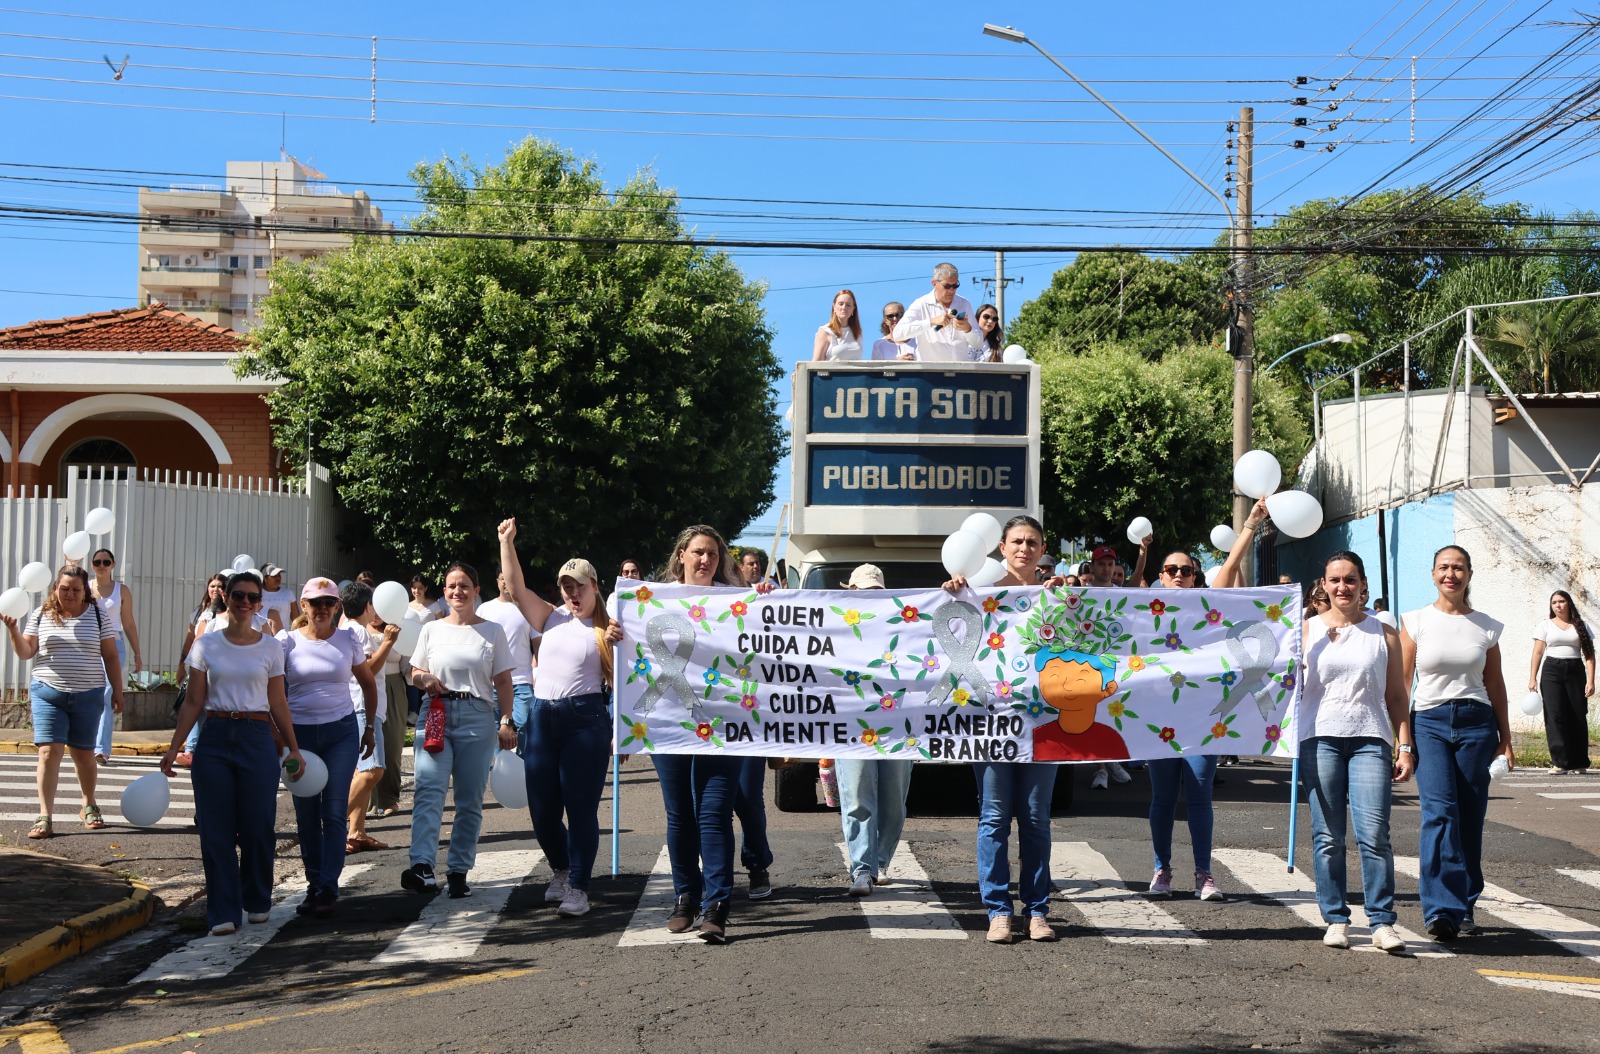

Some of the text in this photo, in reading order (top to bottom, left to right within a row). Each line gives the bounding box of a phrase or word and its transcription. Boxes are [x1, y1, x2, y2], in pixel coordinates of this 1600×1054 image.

[823, 387, 1013, 421] JOTA SOM
[823, 465, 1012, 490] PUBLICIDADE
[761, 605, 824, 627] QUEM
[738, 625, 836, 657] CUIDA DA
[761, 654, 818, 683] VIDA
[769, 685, 837, 714] CUIDA
[725, 720, 857, 745] DA MENTE.
[924, 704, 1024, 738] JANEIRO
[928, 737, 1019, 761] BRANCO
